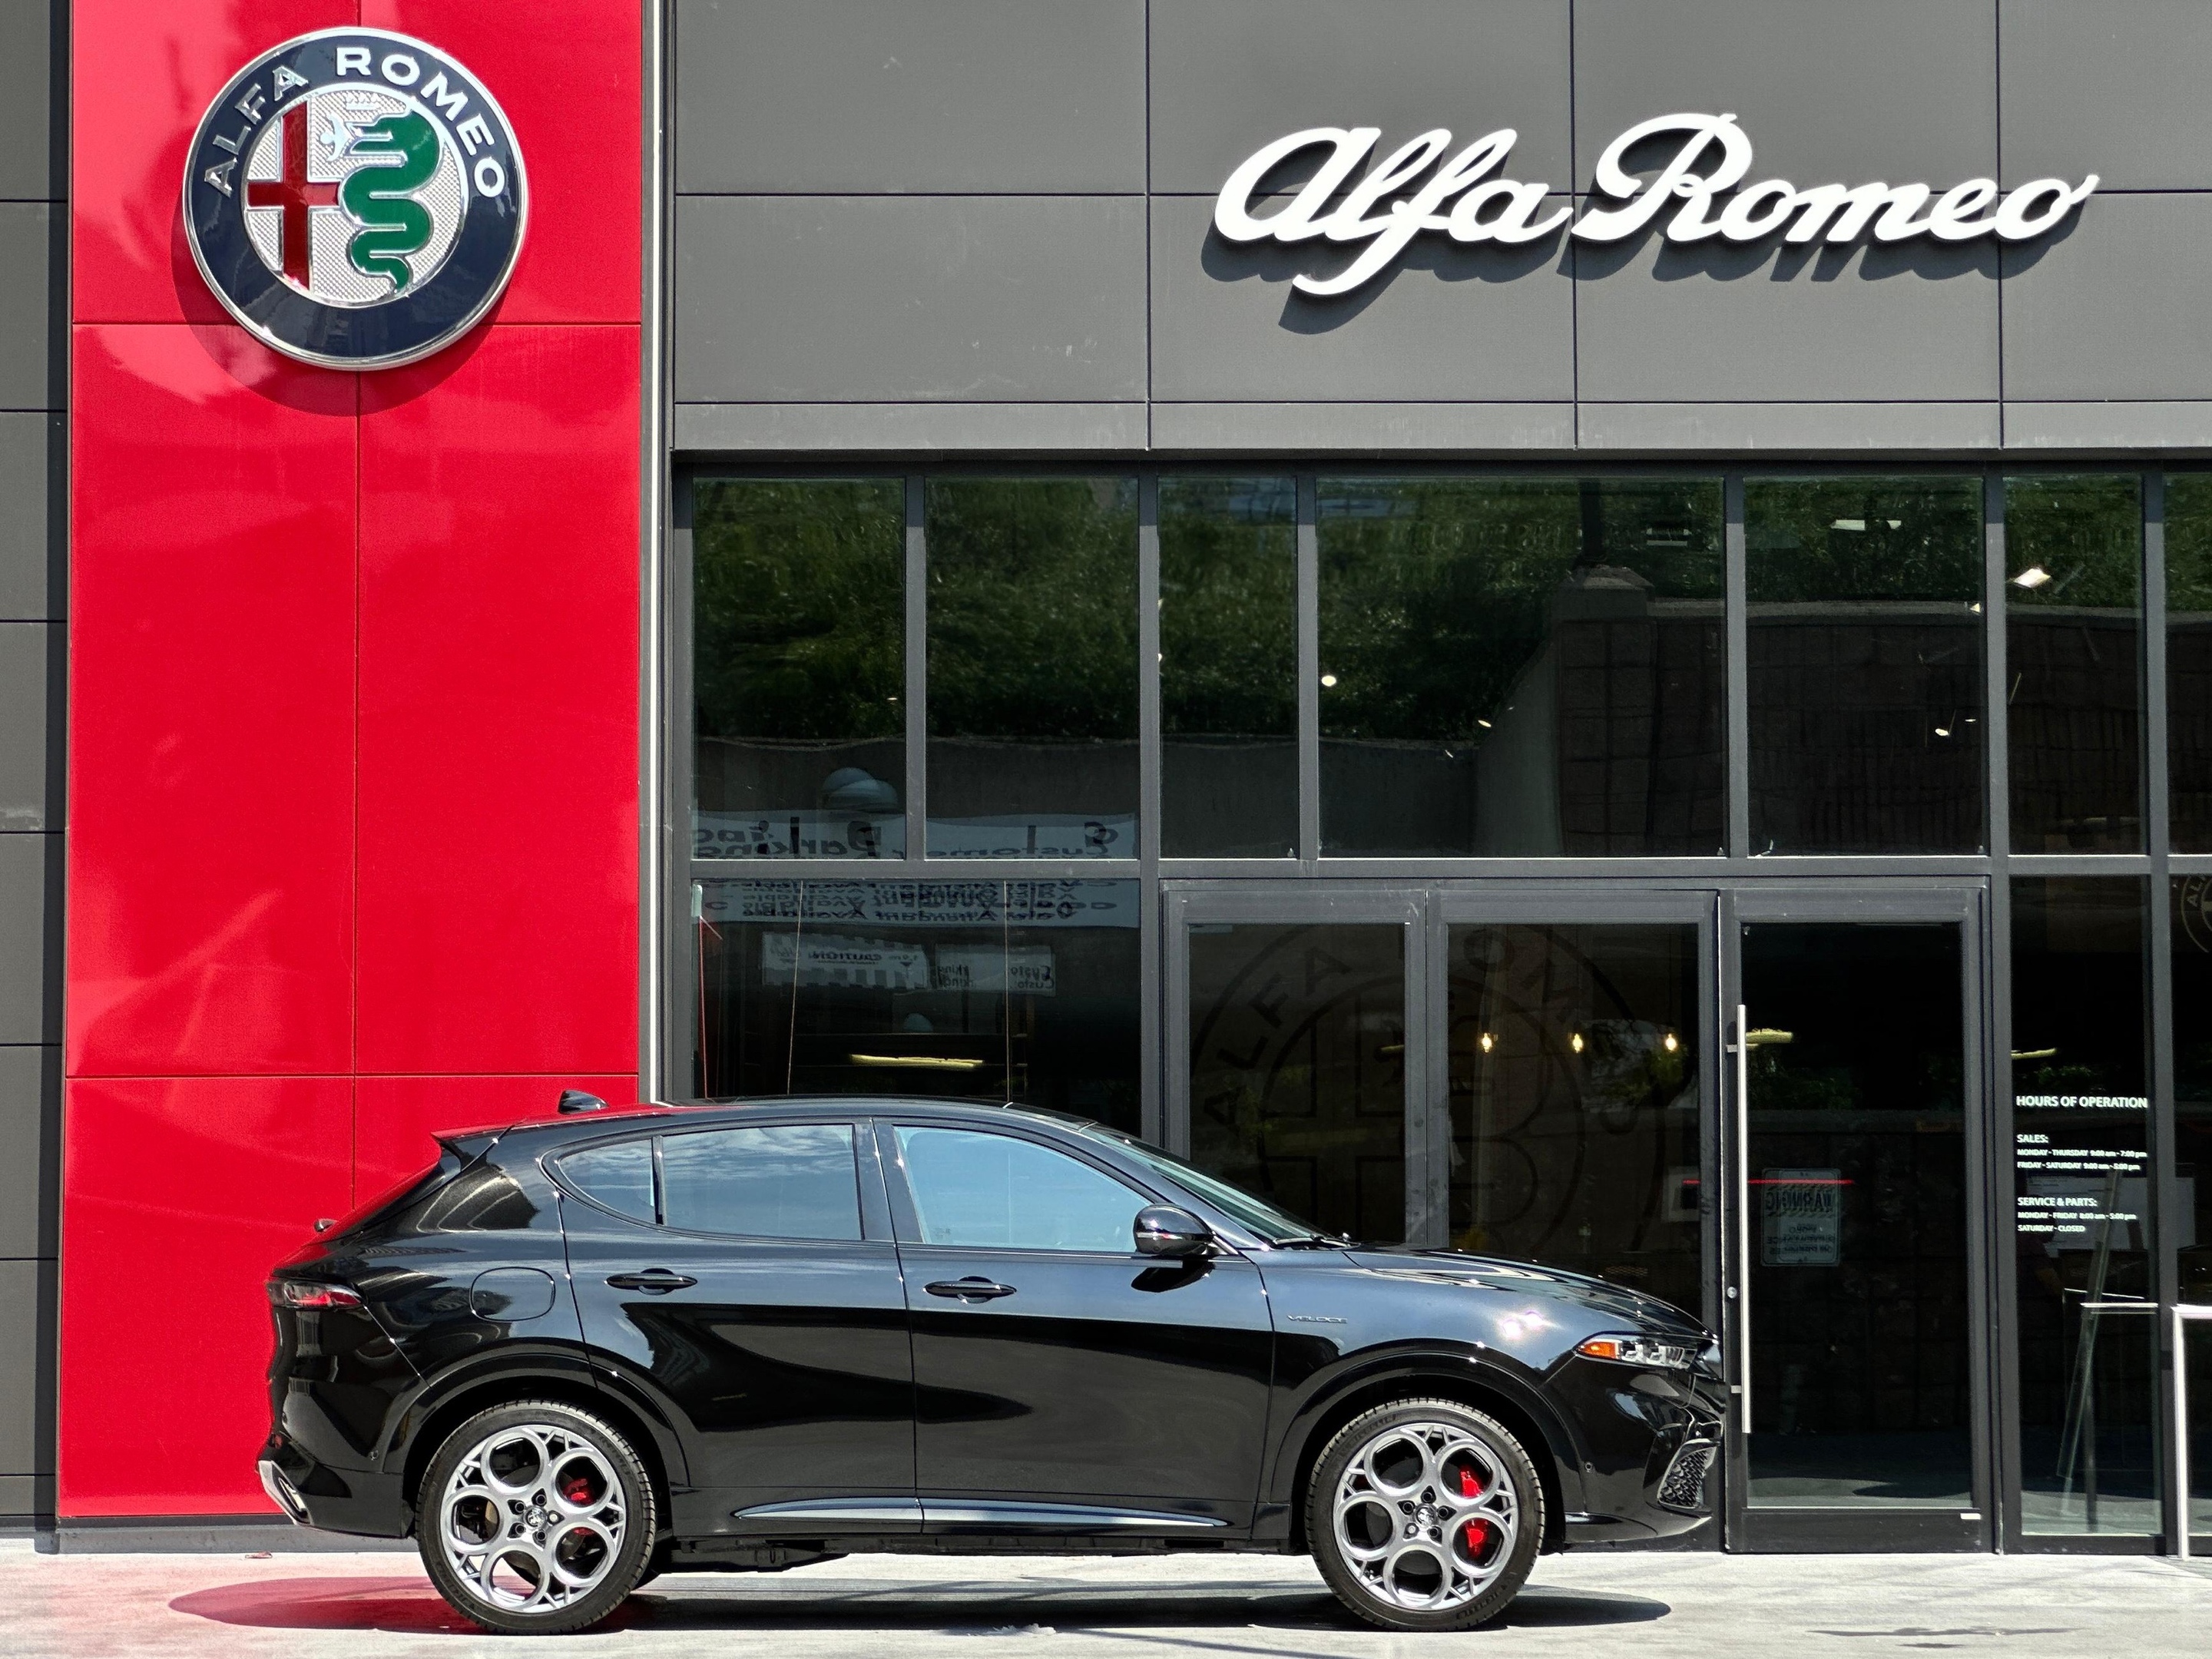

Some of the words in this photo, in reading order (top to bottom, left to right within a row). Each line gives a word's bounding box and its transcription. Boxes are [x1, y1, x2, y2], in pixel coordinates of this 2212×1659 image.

[203, 65, 309, 198] ALFA
[336, 46, 505, 198] ROMEO
[1214, 127, 1574, 295] Alfa
[1571, 113, 2100, 242] Romeo
[2016, 1095, 2058, 1107] HOURS
[2061, 1096, 2077, 1107] OF
[2079, 1097, 2148, 1108] OPERATION
[2017, 1134, 2050, 1144] SALES:
[2017, 1197, 2055, 1206] SERVICE
[2065, 1198, 2098, 1207] PARTS:
